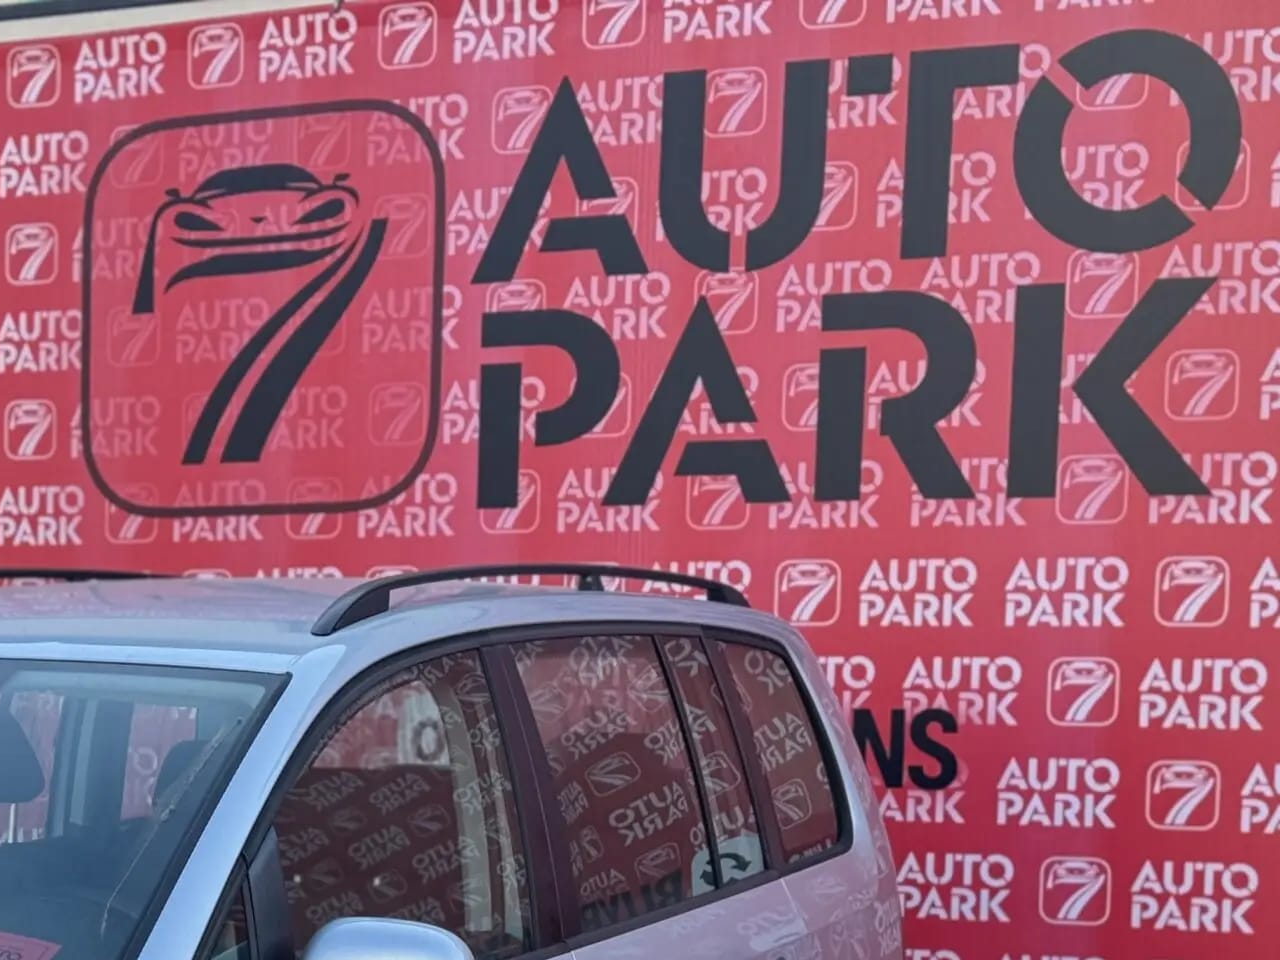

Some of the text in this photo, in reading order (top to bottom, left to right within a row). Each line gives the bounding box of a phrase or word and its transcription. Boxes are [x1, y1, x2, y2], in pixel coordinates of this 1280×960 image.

[260, 9, 356, 48] AUTO
[664, 3, 771, 44] PARK
[75, 31, 166, 69] AUTO
[453, 23, 555, 64] PARK
[260, 44, 354, 83] PARK
[74, 66, 165, 104] PARK
[0, 130, 88, 165] AUTO
[179, 119, 273, 150] AUTO
[471, 28, 1242, 284] AUTO
[1062, 141, 1148, 181] UTO
[0, 162, 86, 197] PARK
[775, 258, 892, 295] AUTO
[920, 251, 1040, 289] AUTO
[1159, 241, 1280, 278] AUTO
[564, 272, 670, 307] AUTO
[176, 299, 269, 331] AUTO
[477, 277, 1218, 508] PARK
[270, 419, 344, 451] ARK
[173, 479, 266, 507] AUTO
[910, 495, 1025, 527] PARK
[1148, 492, 1273, 525] PARK
[173, 513, 264, 542] PARK
[357, 505, 454, 538] PARK
[557, 500, 660, 532] PARK
[768, 497, 878, 530] PARK
[859, 557, 977, 592] AUTO
[1005, 556, 1130, 592] AUTO
[859, 590, 974, 627] PARK
[1005, 590, 1124, 628] PARK
[818, 656, 875, 690] TO
[902, 656, 1022, 692] AUTO
[1140, 657, 1268, 694] AUTO
[1140, 694, 1264, 732] PARK
[852, 708, 958, 790] NS
[997, 758, 1120, 794] AUTO
[876, 789, 964, 824] ARK
[996, 792, 1117, 829] PARK
[897, 852, 1015, 887] AUTO
[1131, 860, 1259, 898] AUTO
[900, 886, 1010, 923] PARK
[1130, 896, 1255, 935] PARK
